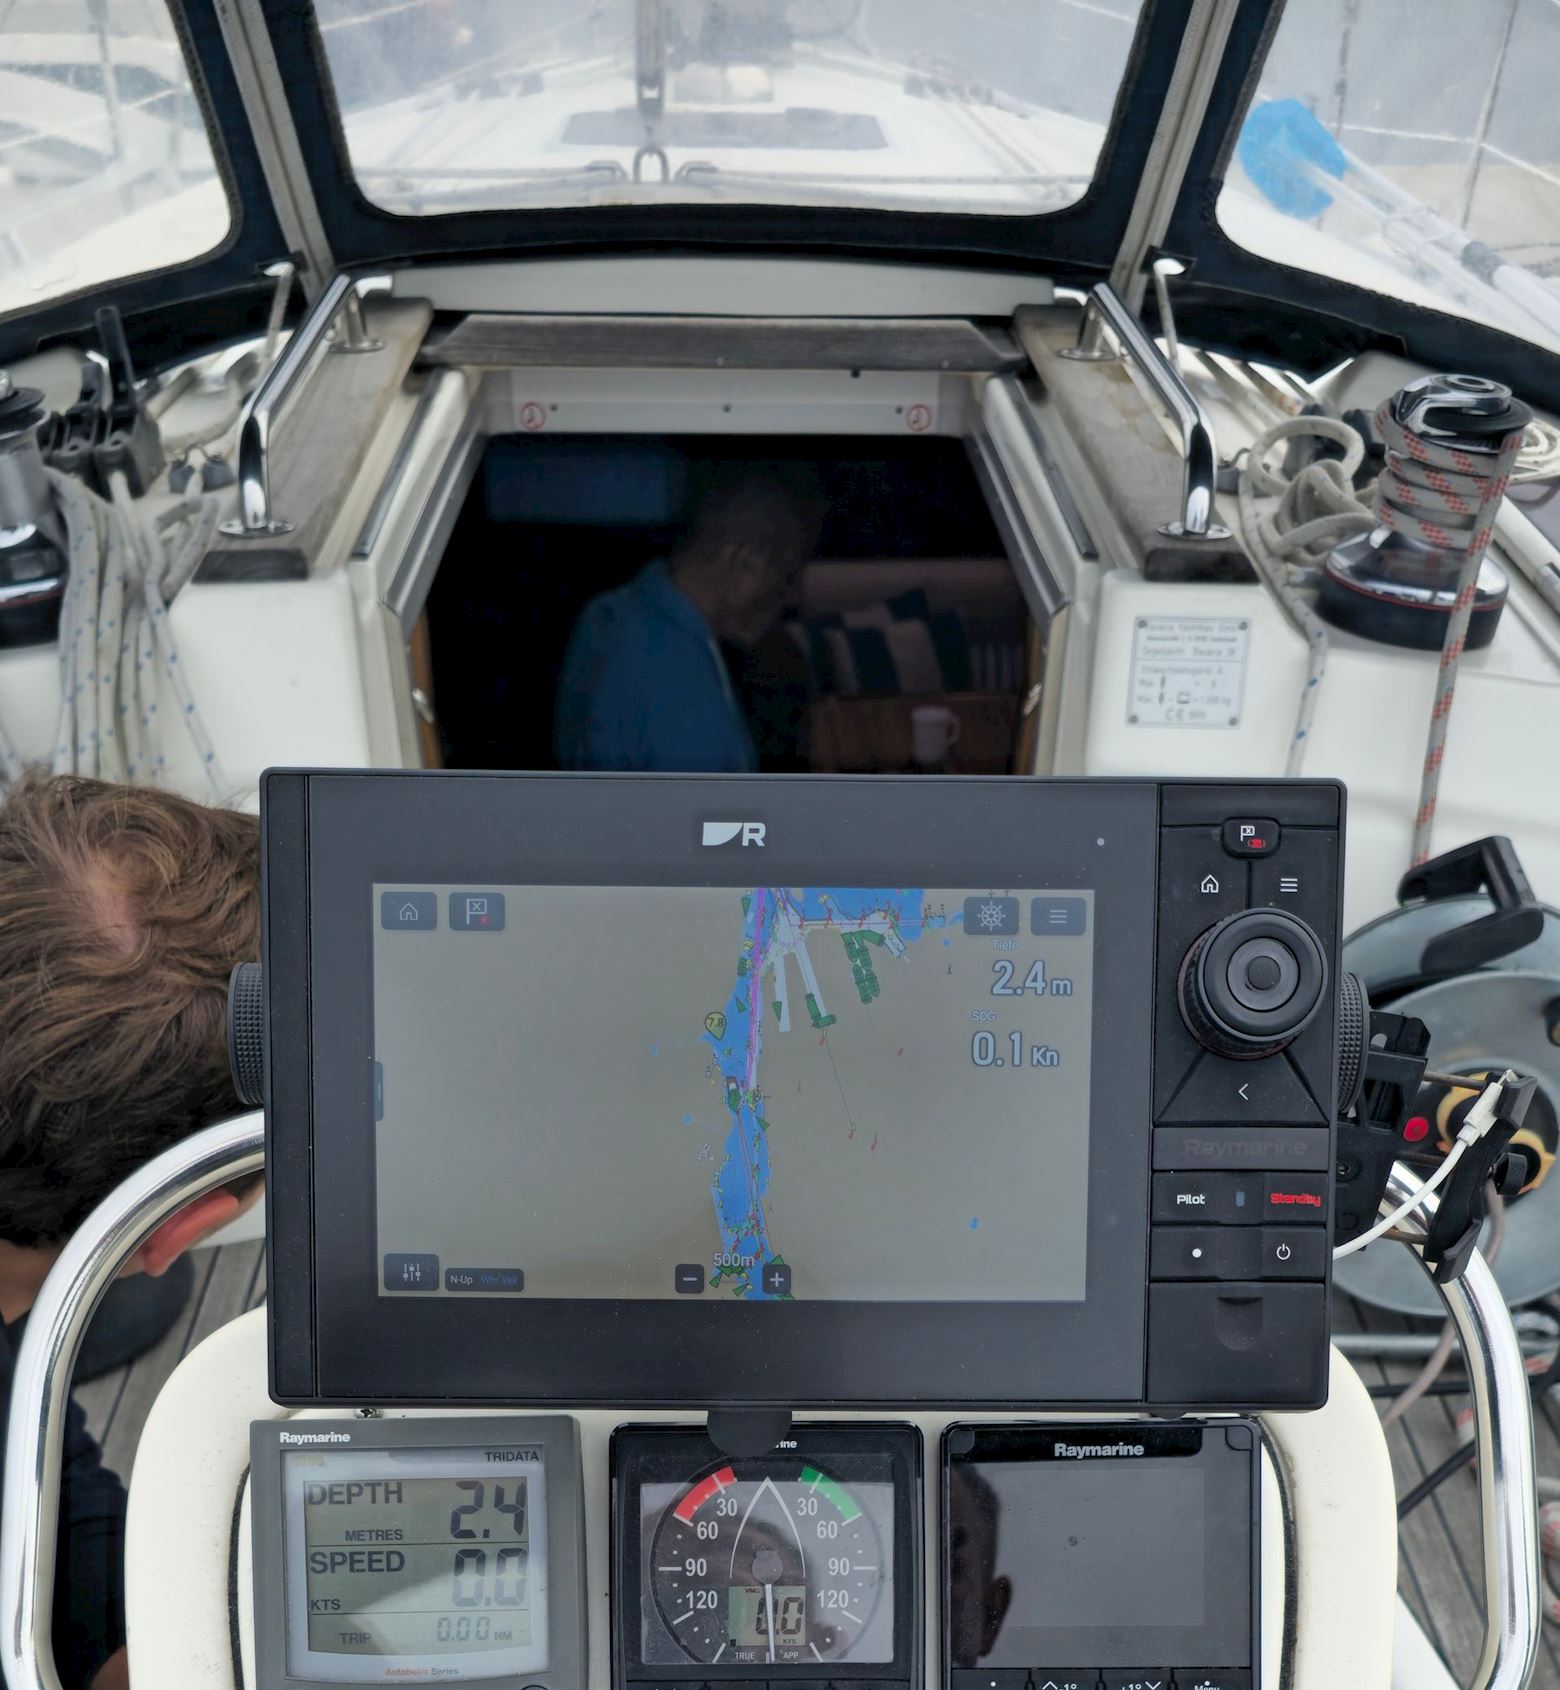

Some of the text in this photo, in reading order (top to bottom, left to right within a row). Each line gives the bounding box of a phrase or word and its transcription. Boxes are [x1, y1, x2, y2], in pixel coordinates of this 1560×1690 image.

[742, 822, 766, 847] R
[991, 960, 1073, 996] 2.4 m
[707, 1018, 724, 1028] 7.8
[972, 1009, 997, 1021] SOG
[972, 1031, 1060, 1067] 0.1 Kn
[1184, 1138, 1307, 1159] Raymarine
[1176, 1194, 1206, 1206] Pilot
[1270, 1193, 1322, 1208] Standby
[713, 1252, 755, 1267] 500m
[450, 1274, 473, 1287] N-Up
[279, 1431, 351, 1445] Raymarine
[485, 1451, 539, 1462] TRIDATA
[1054, 1442, 1144, 1459] Raymarine
[308, 1482, 403, 1505] DEPTH
[450, 1480, 527, 1539] 2.4
[716, 1498, 738, 1517] 30
[796, 1497, 818, 1517] 30
[345, 1528, 404, 1542] METRES
[697, 1521, 719, 1541] 60
[816, 1520, 838, 1540] 60
[309, 1550, 405, 1574] SPEED
[685, 1558, 707, 1577] 90
[828, 1558, 850, 1577] 90
[452, 1548, 529, 1607] 0.0
[310, 1598, 341, 1611] KTS
[686, 1590, 718, 1609] 120
[817, 1590, 849, 1609] 120
[437, 1616, 513, 1642] 0.00 NM
[339, 1633, 372, 1645] TRIP
[735, 1652, 756, 1660] TRUE
[783, 1651, 799, 1660] APP
[431, 1666, 459, 1676] Series
